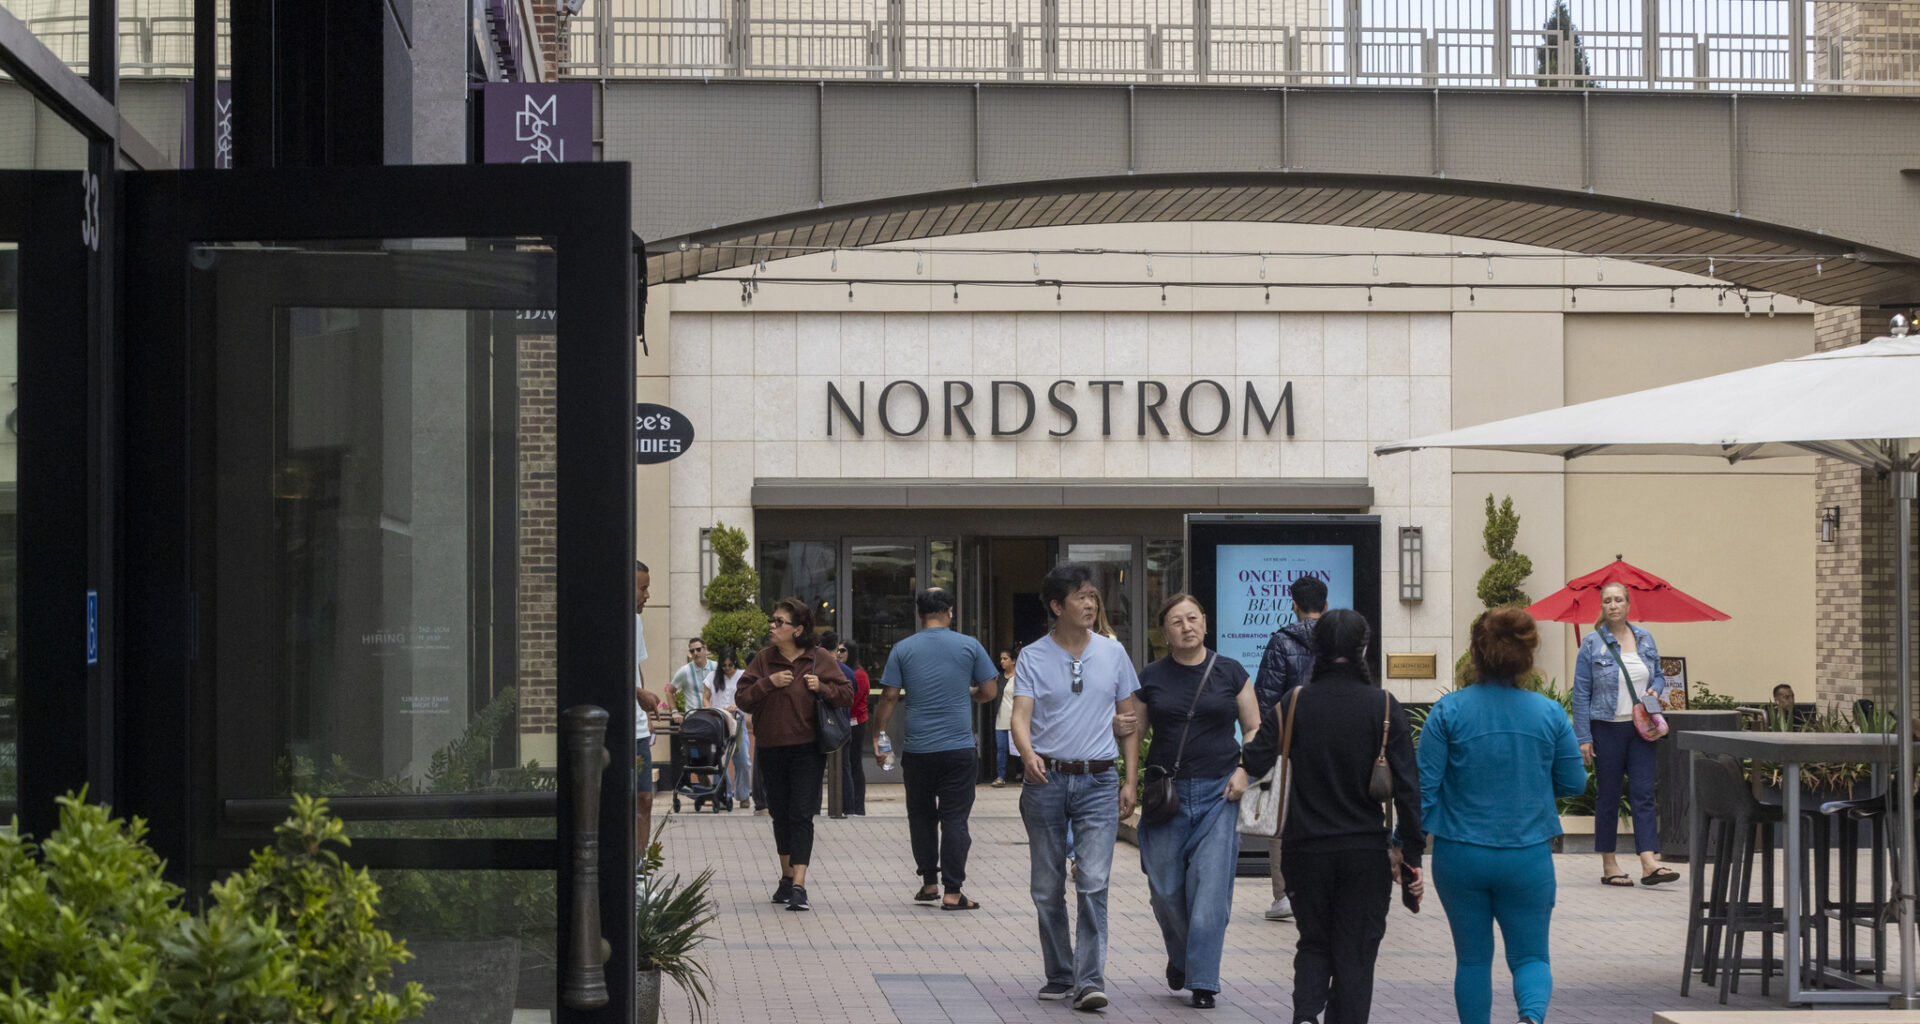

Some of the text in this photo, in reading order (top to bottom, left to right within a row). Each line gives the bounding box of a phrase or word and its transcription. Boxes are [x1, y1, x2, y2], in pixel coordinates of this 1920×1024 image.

[82, 168, 99, 252] 33
[826, 379, 1295, 437] NORDSTROM
[636, 413, 671, 430] ee's
[636, 438, 681, 453] DIES
[1238, 569, 1282, 583] ONCE
[1246, 584, 1292, 597] A STR
[362, 633, 405, 645] HIRING
